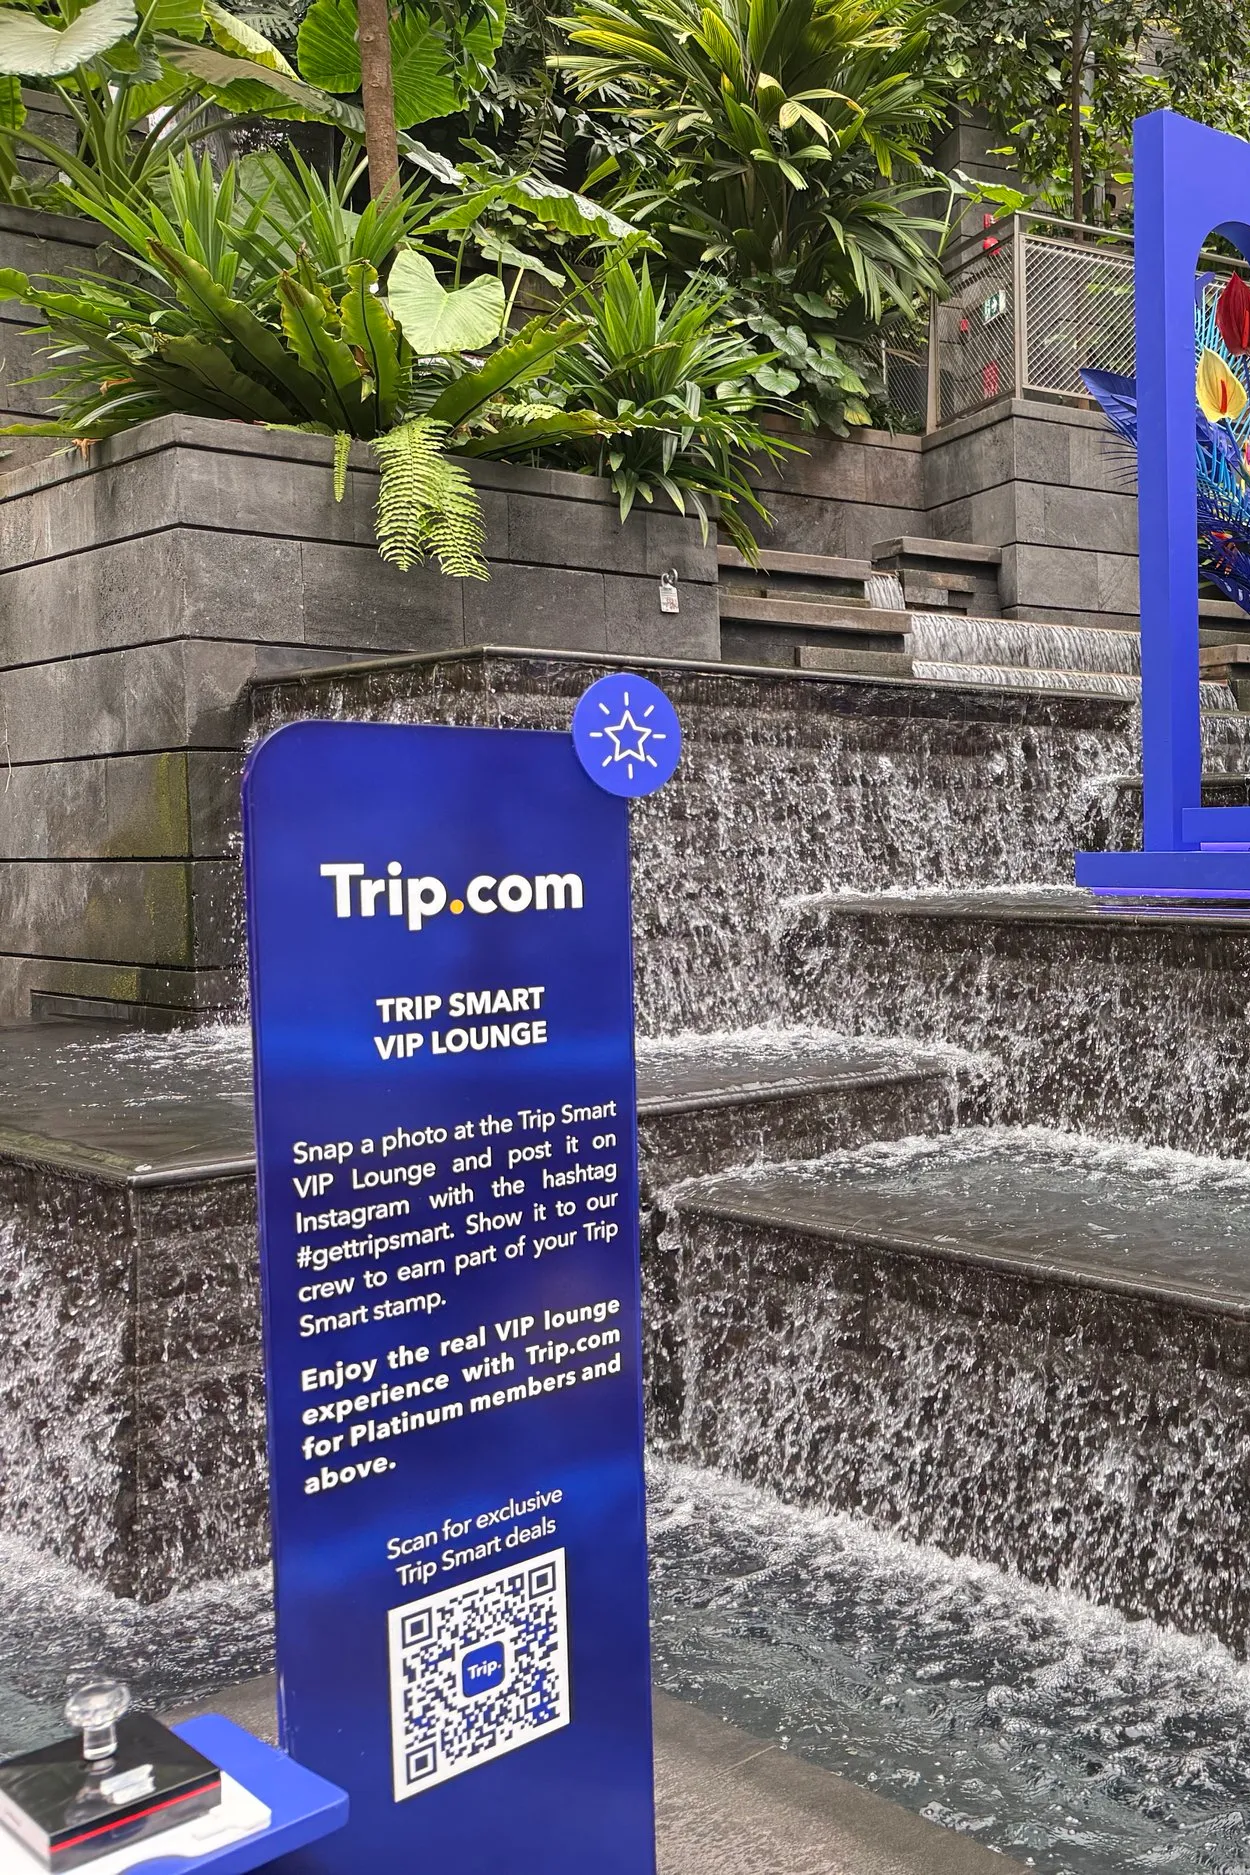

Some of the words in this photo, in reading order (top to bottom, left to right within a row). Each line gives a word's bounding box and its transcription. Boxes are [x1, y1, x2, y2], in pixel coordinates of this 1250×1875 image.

[320, 861, 584, 931] Trip.com
[376, 995, 442, 1023] TRIP
[449, 987, 545, 1016] SMART
[374, 1032, 424, 1060] VIP
[432, 1021, 547, 1055] LOUNGE
[293, 1139, 353, 1164] Snap
[361, 1139, 374, 1154] a
[382, 1127, 447, 1156] photo
[454, 1121, 474, 1140] at
[479, 1115, 513, 1136] the
[518, 1109, 555, 1131] Trip
[561, 1100, 616, 1124] Smart
[293, 1173, 334, 1198] VIP
[352, 1160, 436, 1190] Lounge
[452, 1147, 492, 1173] and
[508, 1141, 551, 1165] post
[566, 1135, 578, 1153] it
[592, 1133, 616, 1150] on
[296, 1200, 410, 1234] Instagram
[429, 1183, 474, 1209] with
[492, 1177, 525, 1198] the
[543, 1162, 617, 1189] hashtag
[297, 1223, 455, 1271] #gettripsmart.
[466, 1213, 522, 1235] Show
[534, 1203, 546, 1221] it
[556, 1200, 576, 1217] to
[587, 1192, 618, 1211] our
[298, 1278, 354, 1303] crew
[364, 1269, 387, 1288] to
[397, 1258, 445, 1281] earn
[455, 1248, 497, 1275] part
[505, 1236, 525, 1260] of
[533, 1232, 576, 1259] your
[584, 1221, 618, 1242] Trip
[300, 1306, 368, 1337] Smart
[373, 1291, 447, 1321] stamp.
[301, 1357, 377, 1392] Enjoy
[387, 1346, 429, 1370] the
[440, 1326, 485, 1356] real
[495, 1316, 534, 1342] VIP
[544, 1299, 620, 1330] lounge
[302, 1374, 449, 1425] experience
[462, 1353, 515, 1382] with
[526, 1328, 621, 1364] Trip.com
[302, 1434, 343, 1460] for
[350, 1402, 463, 1448] Platinum
[470, 1370, 576, 1413] members
[581, 1353, 621, 1381] and
[304, 1455, 396, 1494] above.
[387, 1531, 437, 1560] Scan
[443, 1517, 472, 1541] for
[476, 1488, 563, 1530] exclusive
[396, 1561, 436, 1586] Trip
[442, 1536, 501, 1572] Smart
[505, 1518, 556, 1548] deals
[467, 1661, 502, 1680] Trip.
